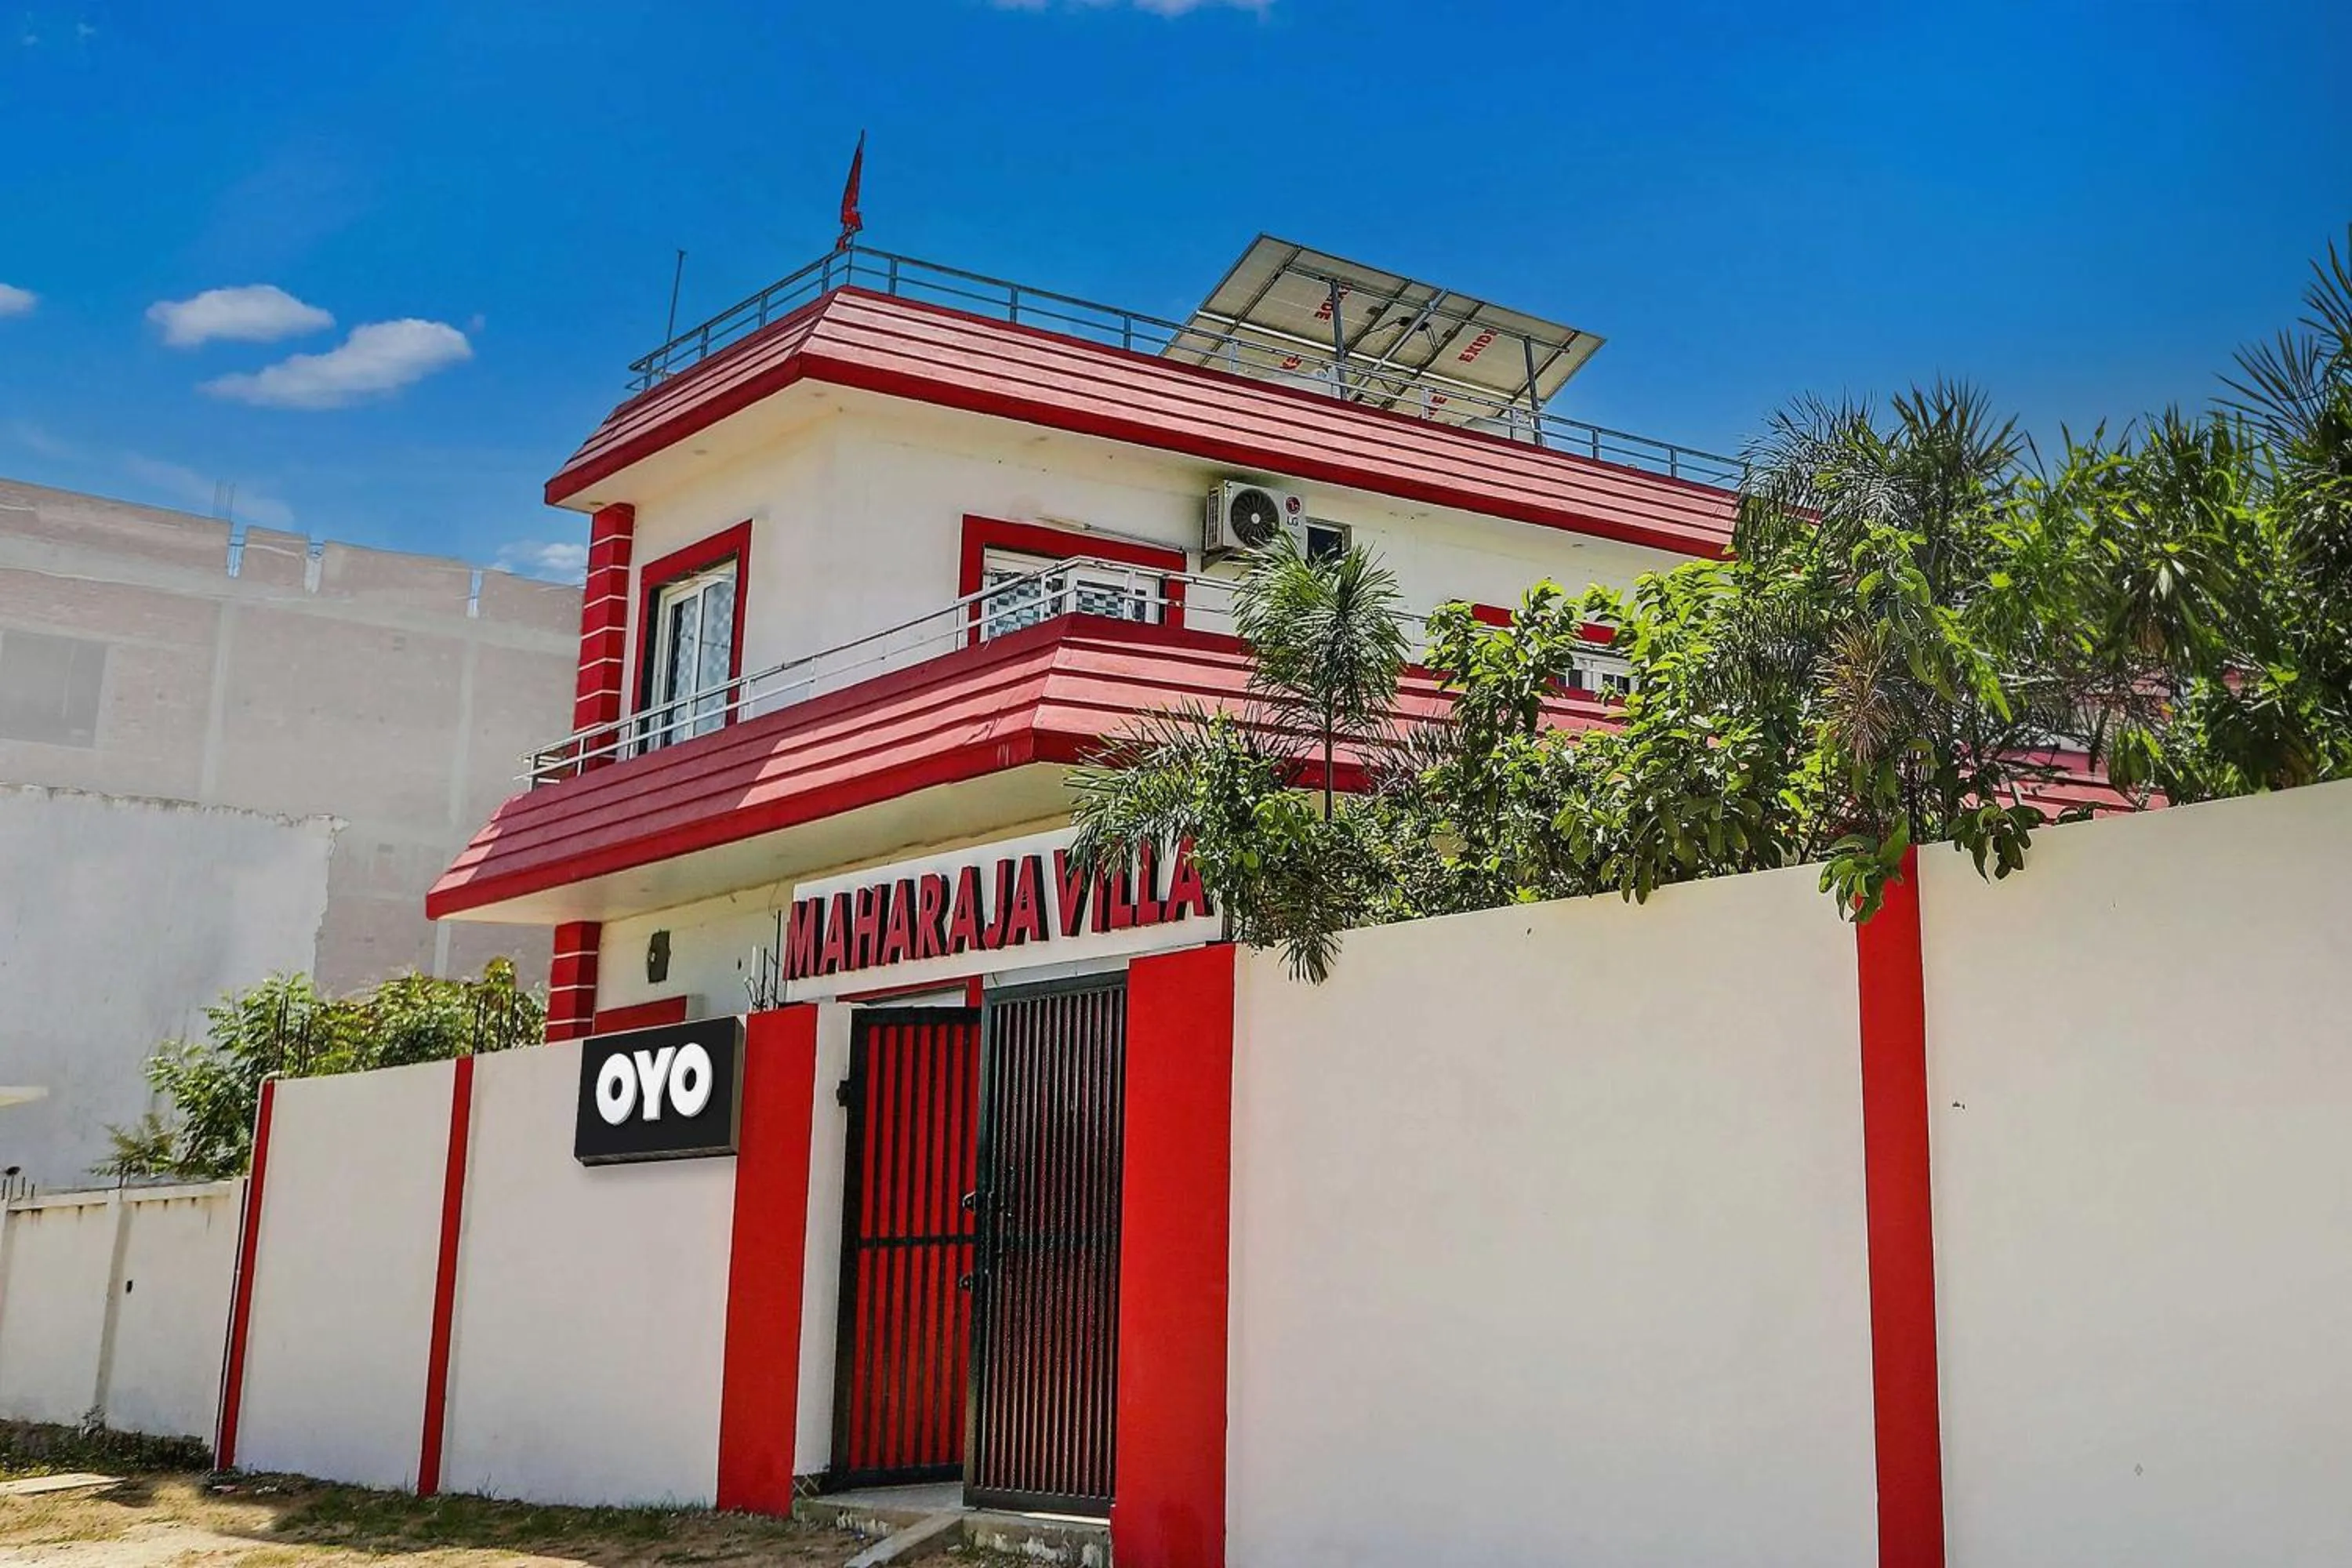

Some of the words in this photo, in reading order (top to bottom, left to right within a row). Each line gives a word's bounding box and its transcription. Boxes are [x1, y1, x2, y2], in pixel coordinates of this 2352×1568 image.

[1287, 516, 1299, 526] LG
[784, 855, 1049, 980] MAHARAJA
[1054, 834, 1215, 936] VILLA
[596, 1043, 713, 1126] OYO
